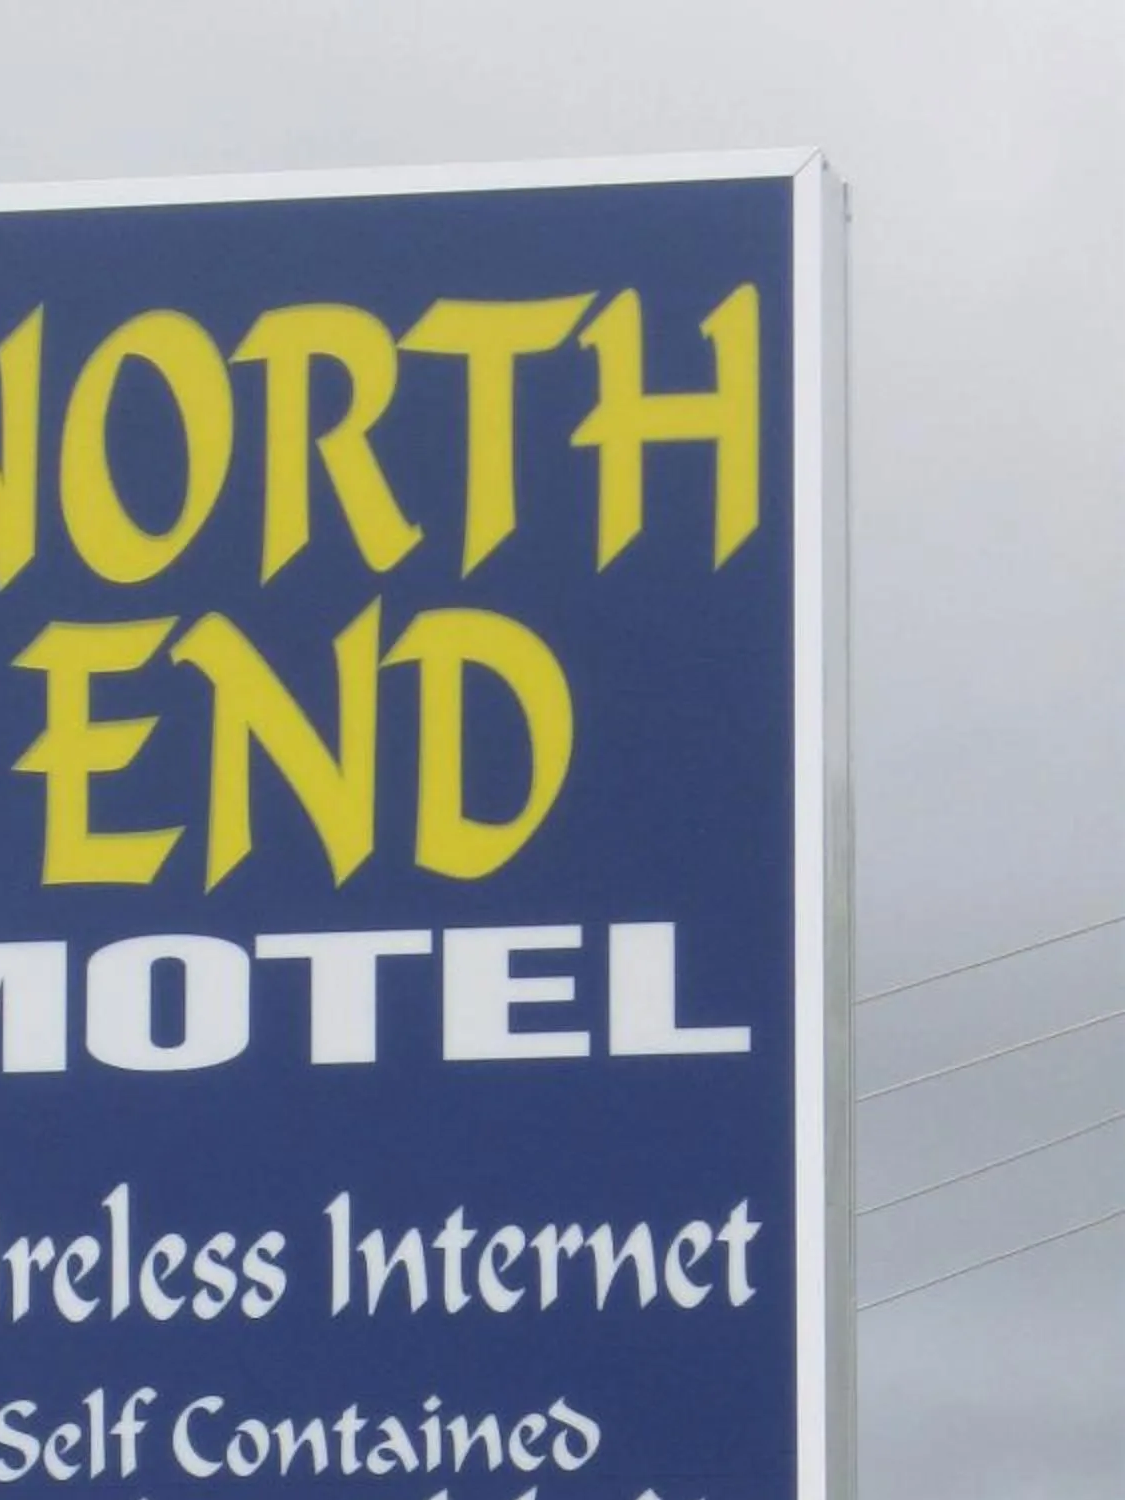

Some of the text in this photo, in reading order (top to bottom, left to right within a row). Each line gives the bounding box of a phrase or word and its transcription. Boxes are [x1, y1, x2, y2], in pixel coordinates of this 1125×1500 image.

[13, 596, 573, 892] END
[325, 1191, 762, 1315] Internet
[173, 1396, 601, 1475] Contained
